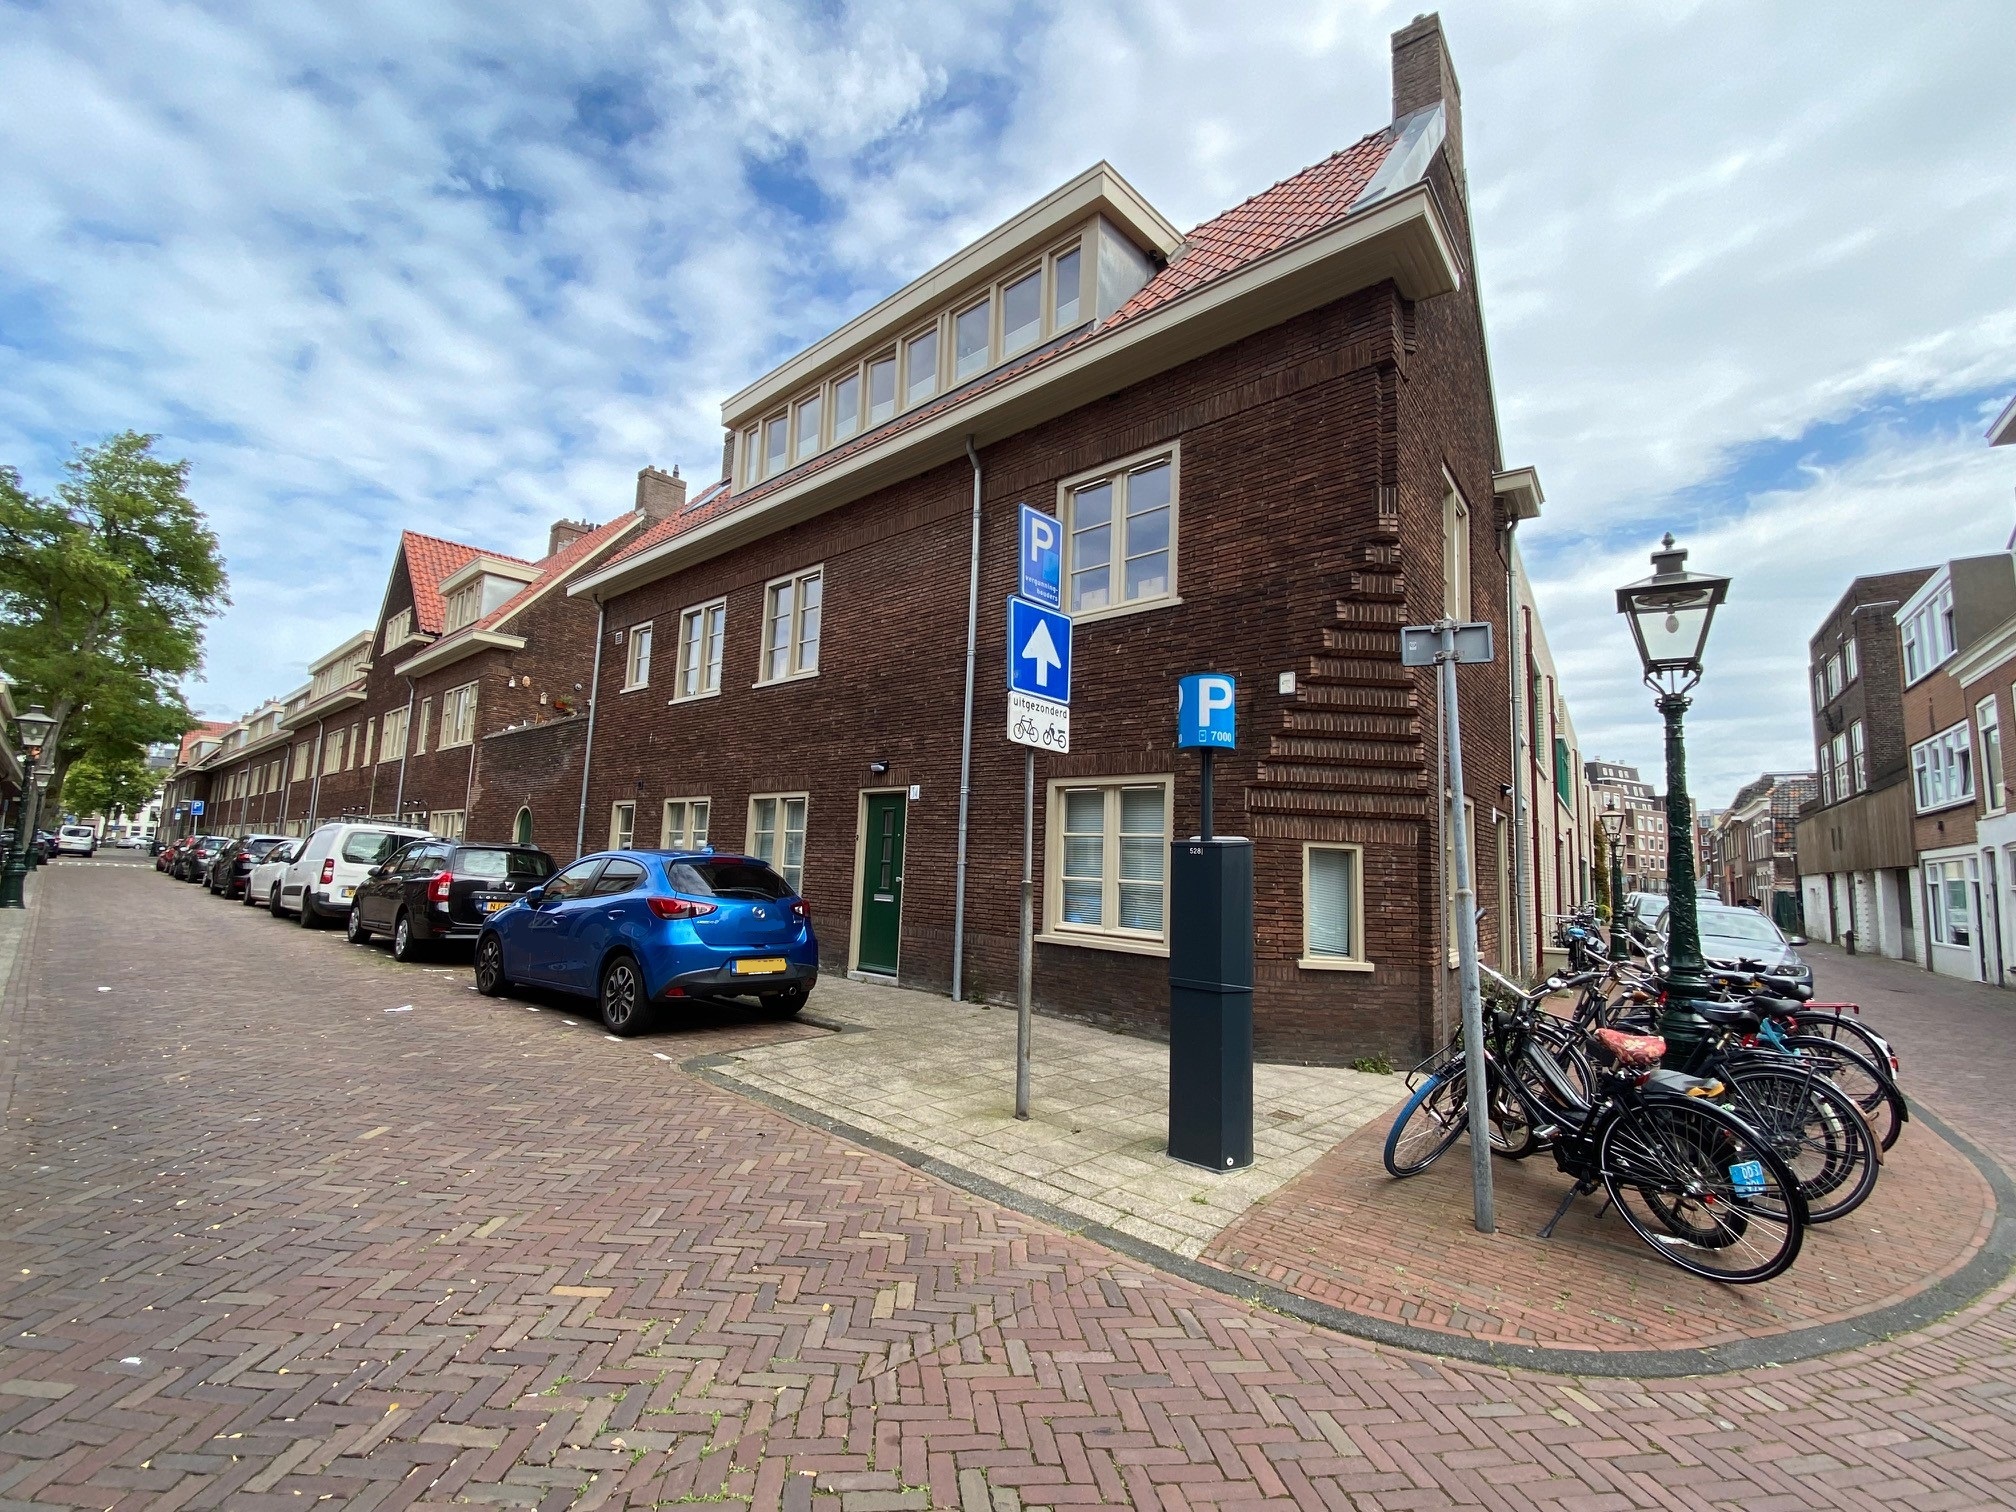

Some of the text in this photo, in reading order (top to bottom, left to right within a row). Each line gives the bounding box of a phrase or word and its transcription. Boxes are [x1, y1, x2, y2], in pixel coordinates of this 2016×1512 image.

[1031, 517, 1054, 562] P
[1037, 588, 1058, 602] houders
[1013, 697, 1067, 719] uitgezonderd
[1198, 677, 1233, 727] P
[1211, 731, 1232, 743] 7000
